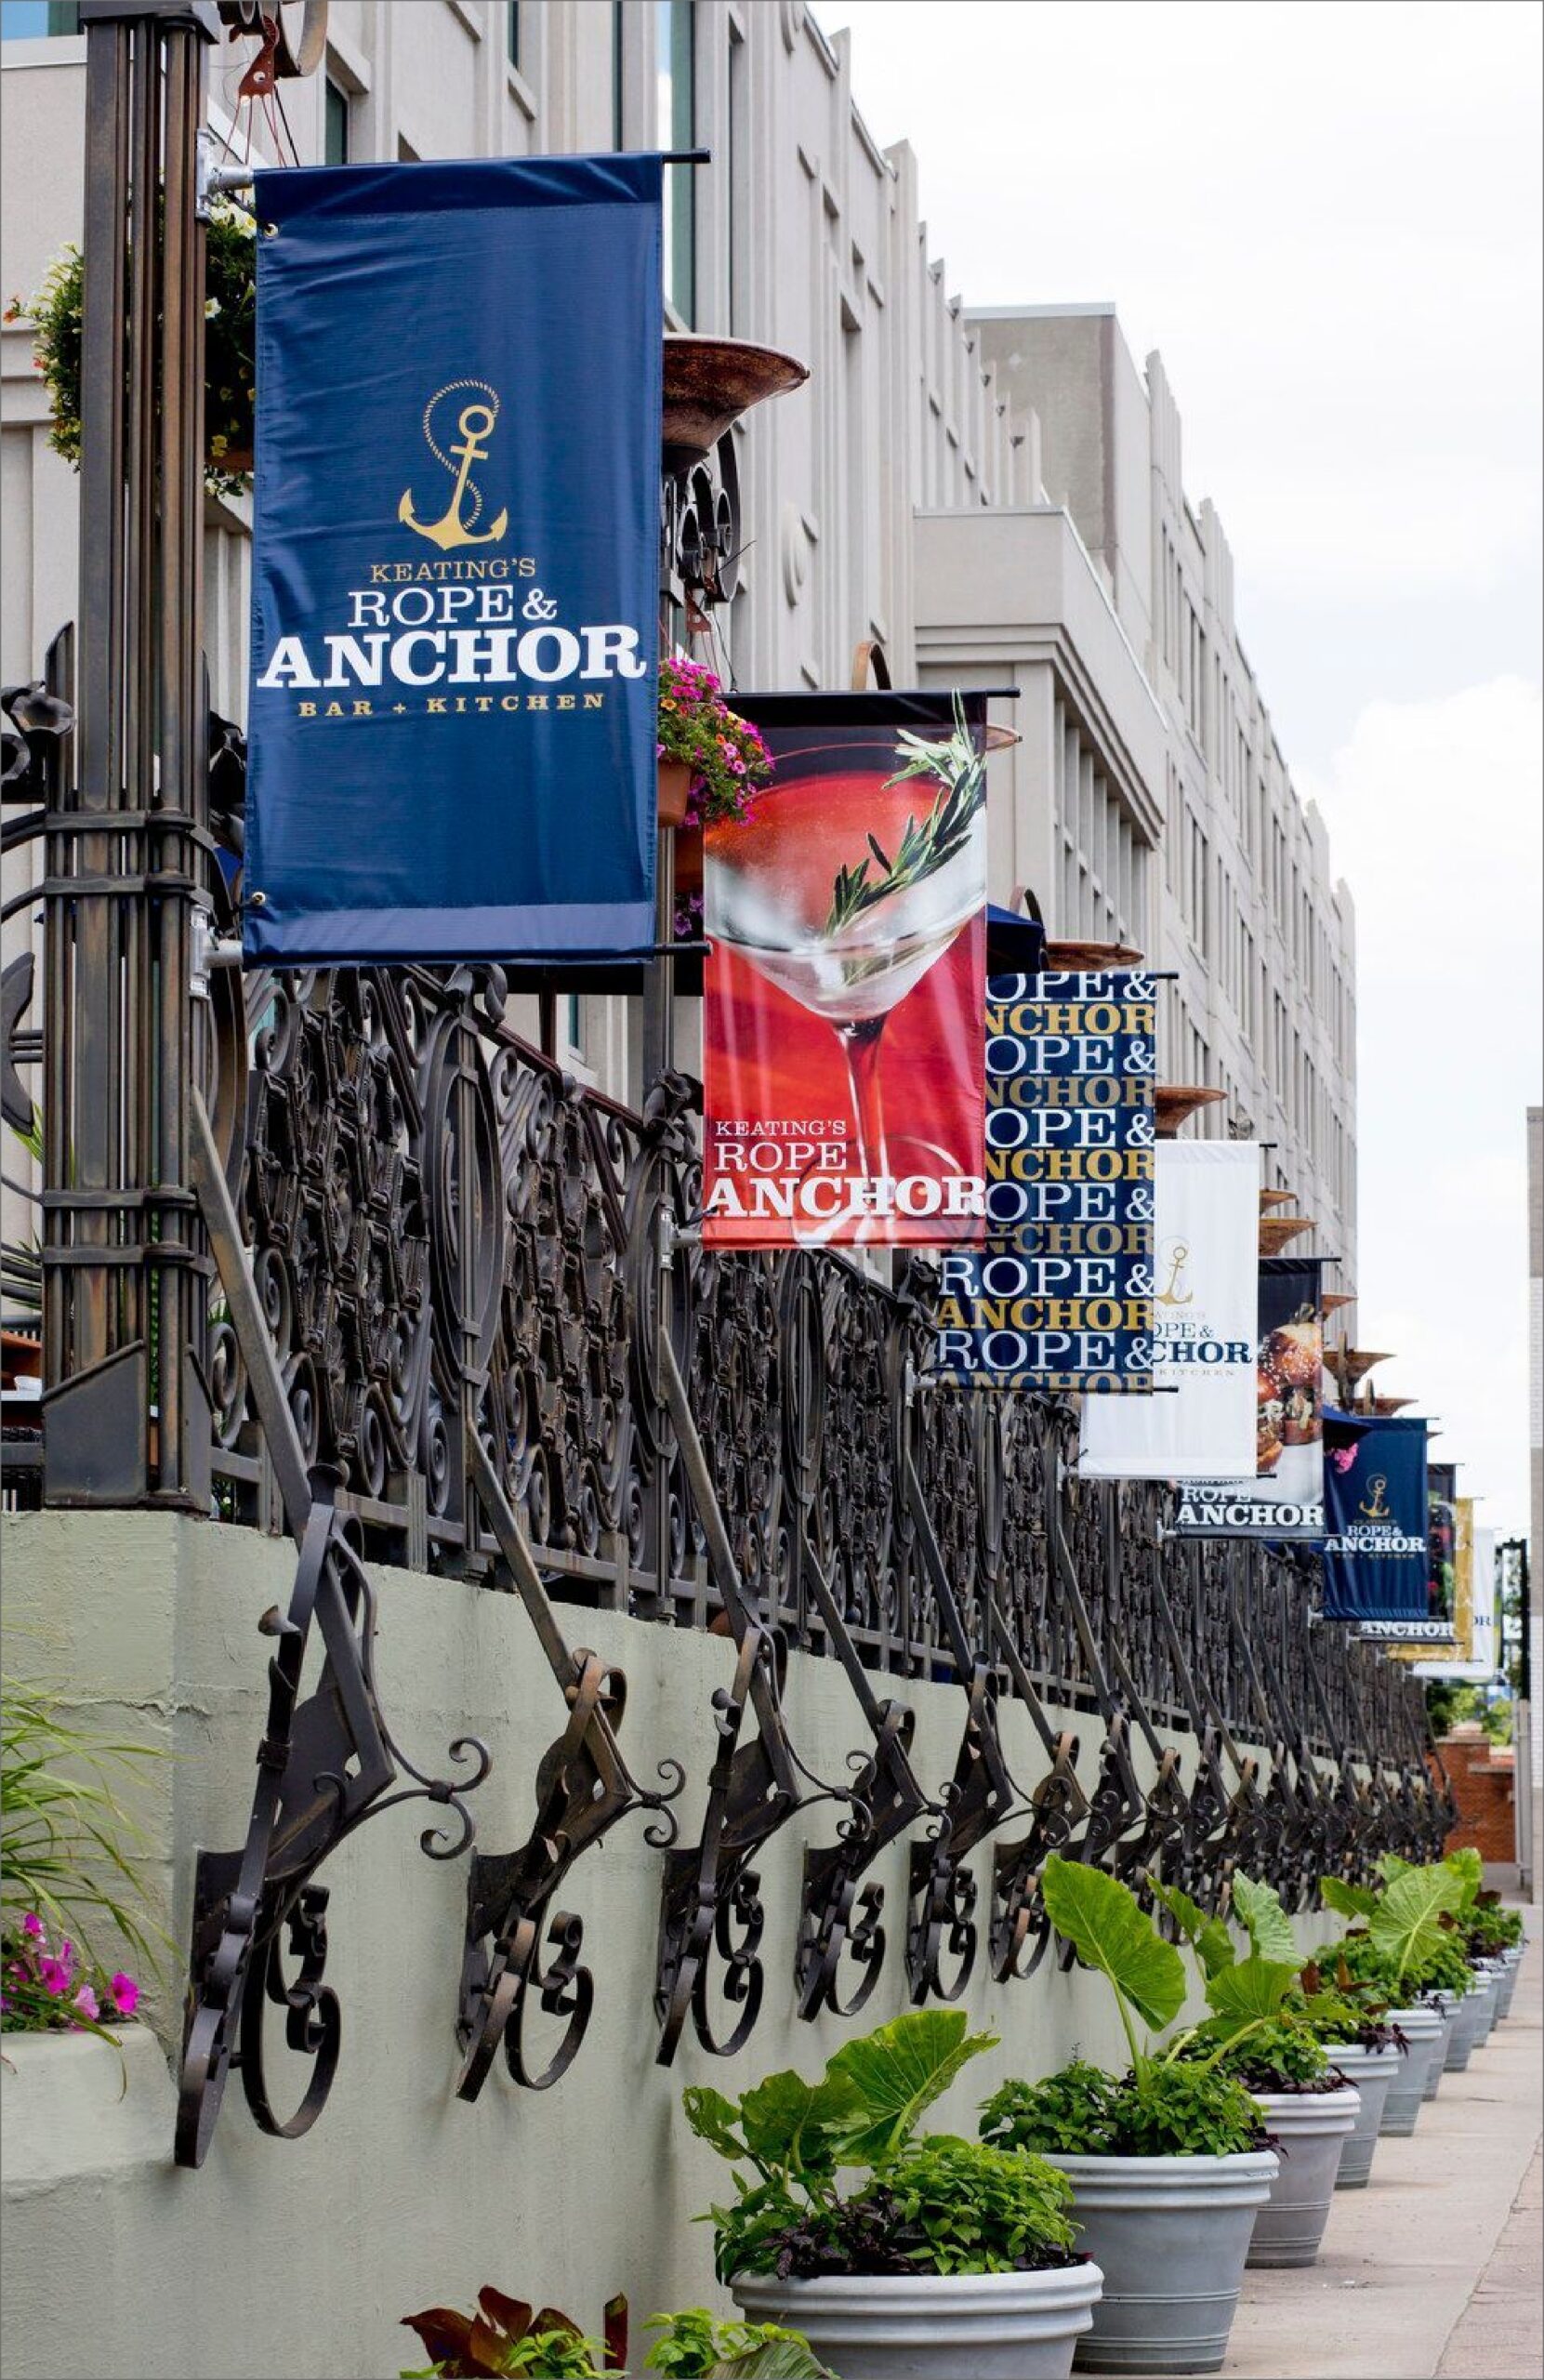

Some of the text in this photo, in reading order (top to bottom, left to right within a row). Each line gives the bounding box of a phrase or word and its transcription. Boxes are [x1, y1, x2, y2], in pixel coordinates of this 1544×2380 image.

[369, 558, 536, 583] KEATING'S
[347, 586, 515, 628] ROPE
[256, 625, 648, 689] ANCHOR
[298, 700, 373, 717] BAR
[426, 693, 605, 715] KITCHEN
[985, 971, 1115, 1002] OPE
[985, 1003, 1155, 1035] NCHOR
[985, 1035, 1115, 1075] OPE
[985, 1077, 1155, 1107] NCHOR
[715, 1119, 847, 1136] KEATING'S
[985, 1108, 1116, 1148] OPE
[714, 1142, 847, 1171] ROPE
[985, 1149, 1155, 1181] NCHOR
[705, 1175, 986, 1219] ANCHOR
[985, 1182, 1115, 1222] OPE
[985, 1223, 1154, 1254] NCHOR
[938, 1257, 1115, 1297] ROPE
[937, 1298, 1154, 1330] ANCHOR
[937, 1330, 1115, 1370] ROPE
[1153, 1341, 1253, 1364] CHOR
[1175, 1503, 1325, 1527] ANCHOR
[1324, 1536, 1427, 1552] ANCHOR
